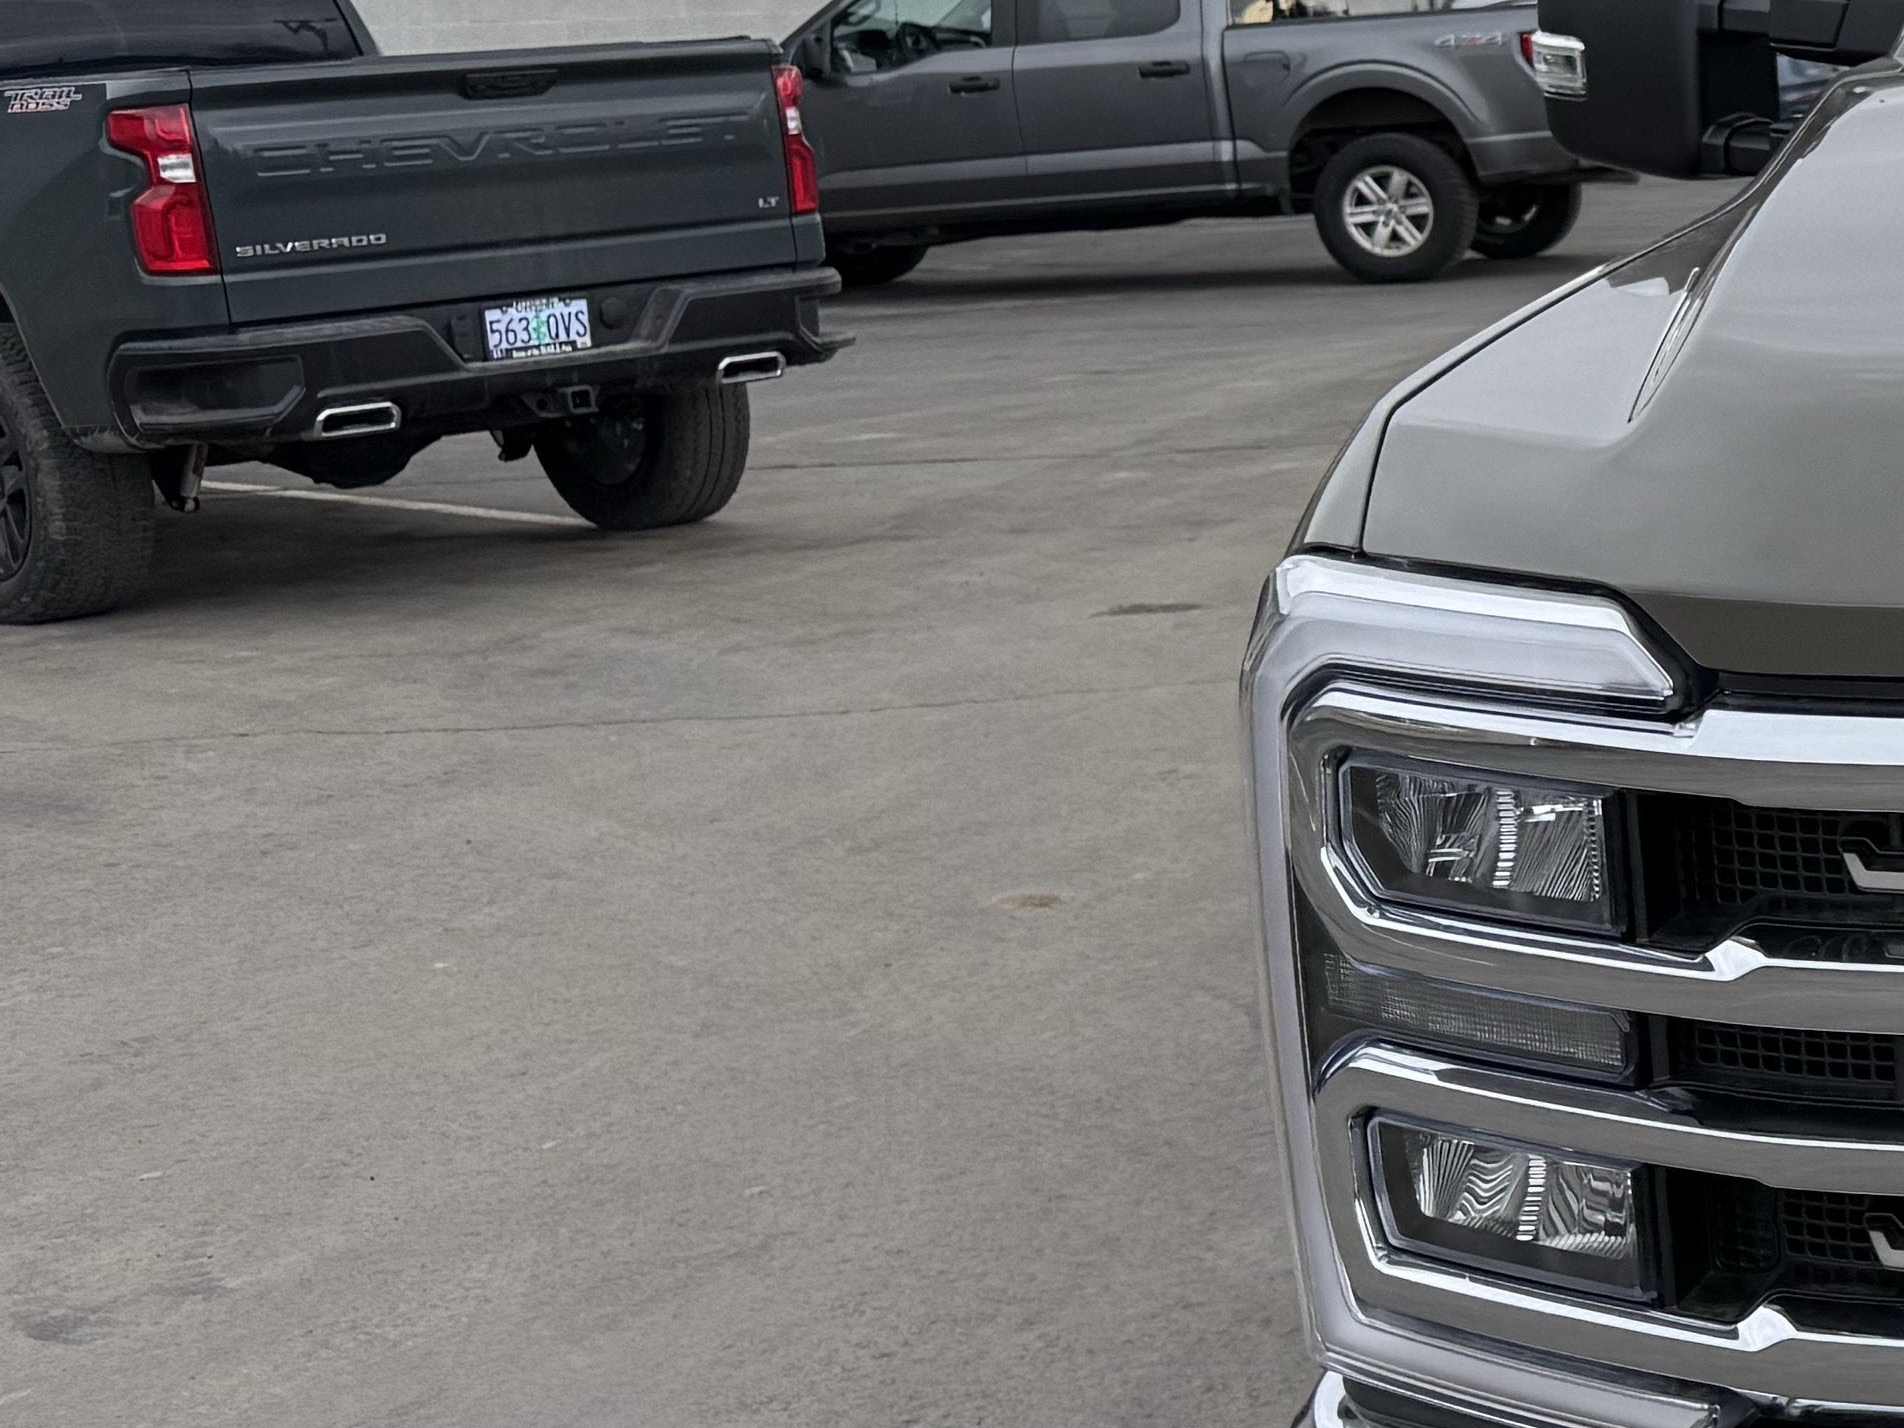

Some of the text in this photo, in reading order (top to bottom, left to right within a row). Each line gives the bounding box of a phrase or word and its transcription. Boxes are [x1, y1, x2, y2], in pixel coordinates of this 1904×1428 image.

[254, 112, 752, 177] CHEVROLET
[758, 196, 780, 209] LT
[235, 233, 387, 257] SILVERADO
[489, 317, 532, 349] 563
